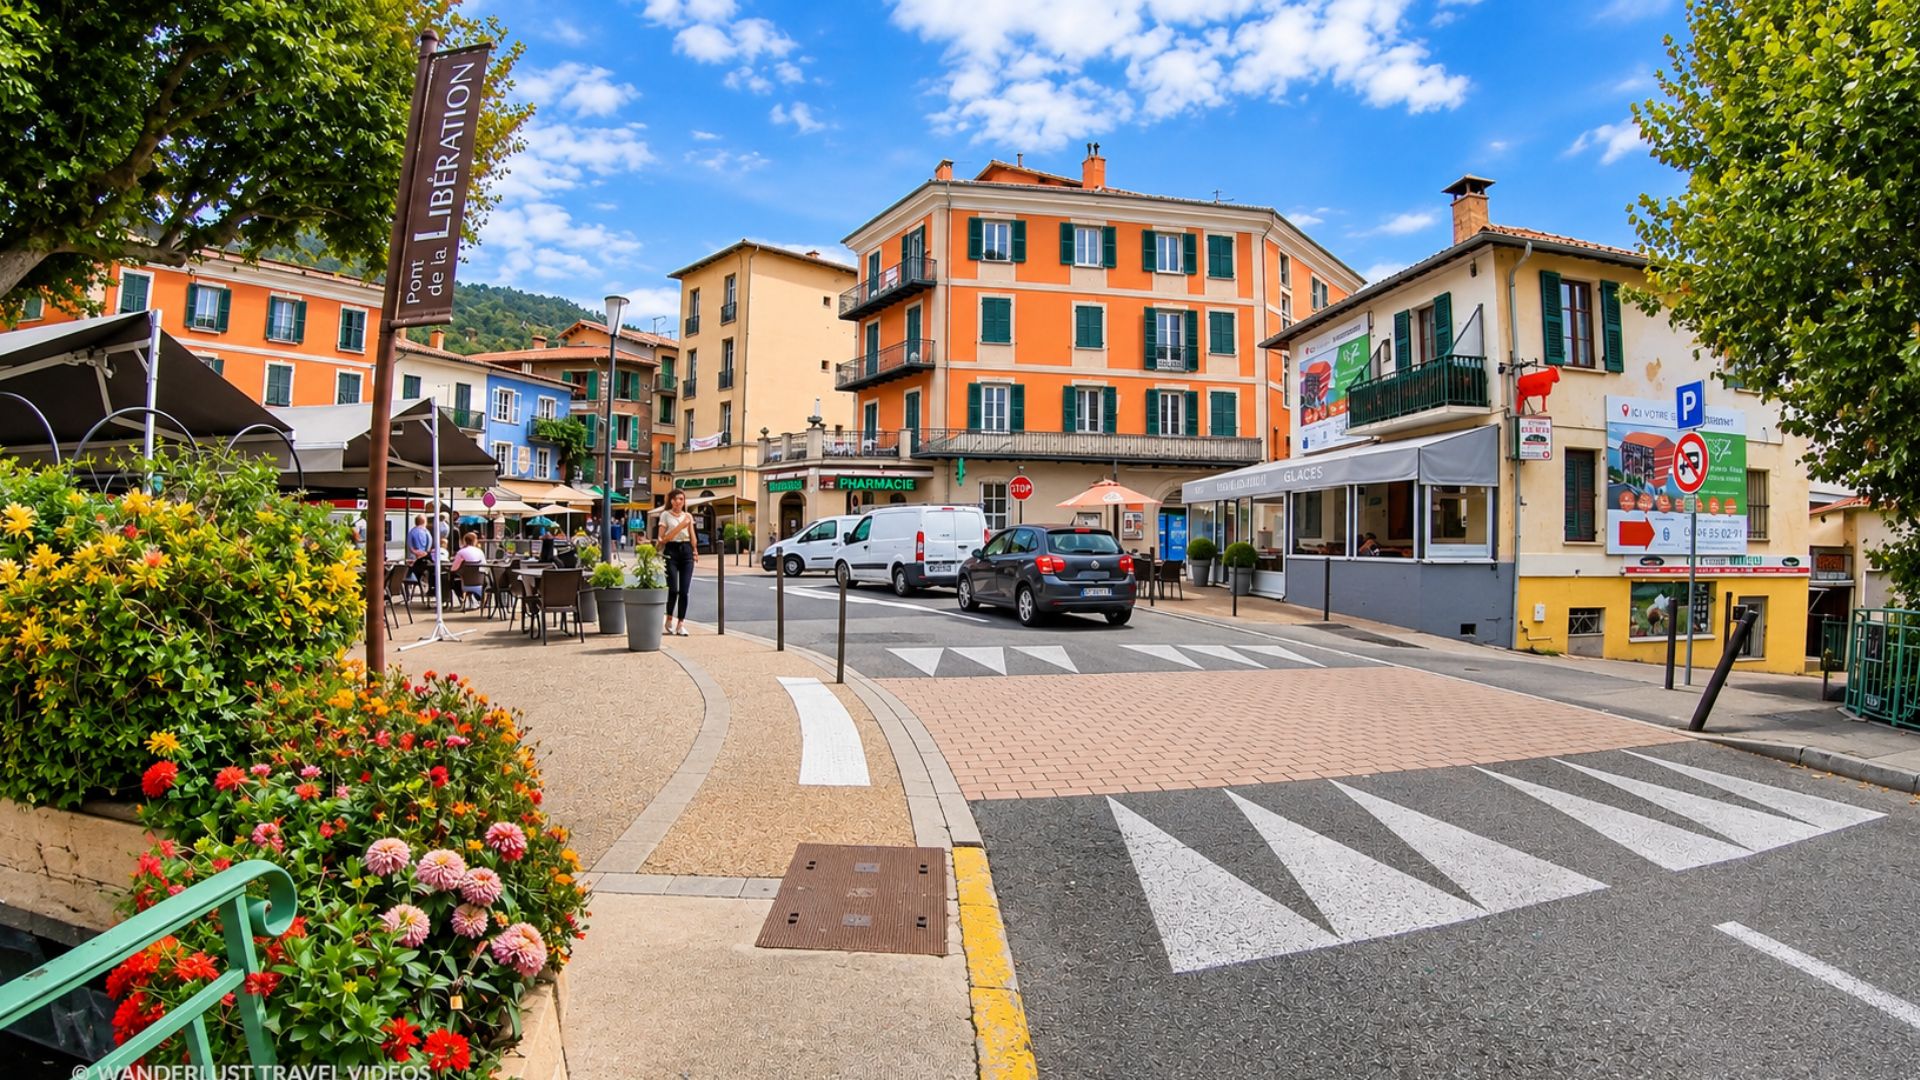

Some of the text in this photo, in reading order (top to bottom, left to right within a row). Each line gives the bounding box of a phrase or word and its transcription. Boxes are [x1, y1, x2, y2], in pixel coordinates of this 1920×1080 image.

[430, 246, 448, 266] la
[406, 259, 425, 304] Pont
[427, 271, 445, 297] de
[1682, 390, 1697, 421] P
[839, 477, 915, 490] PHARMACIE
[1283, 466, 1324, 483] GLACES
[1010, 484, 1031, 493] STOP
